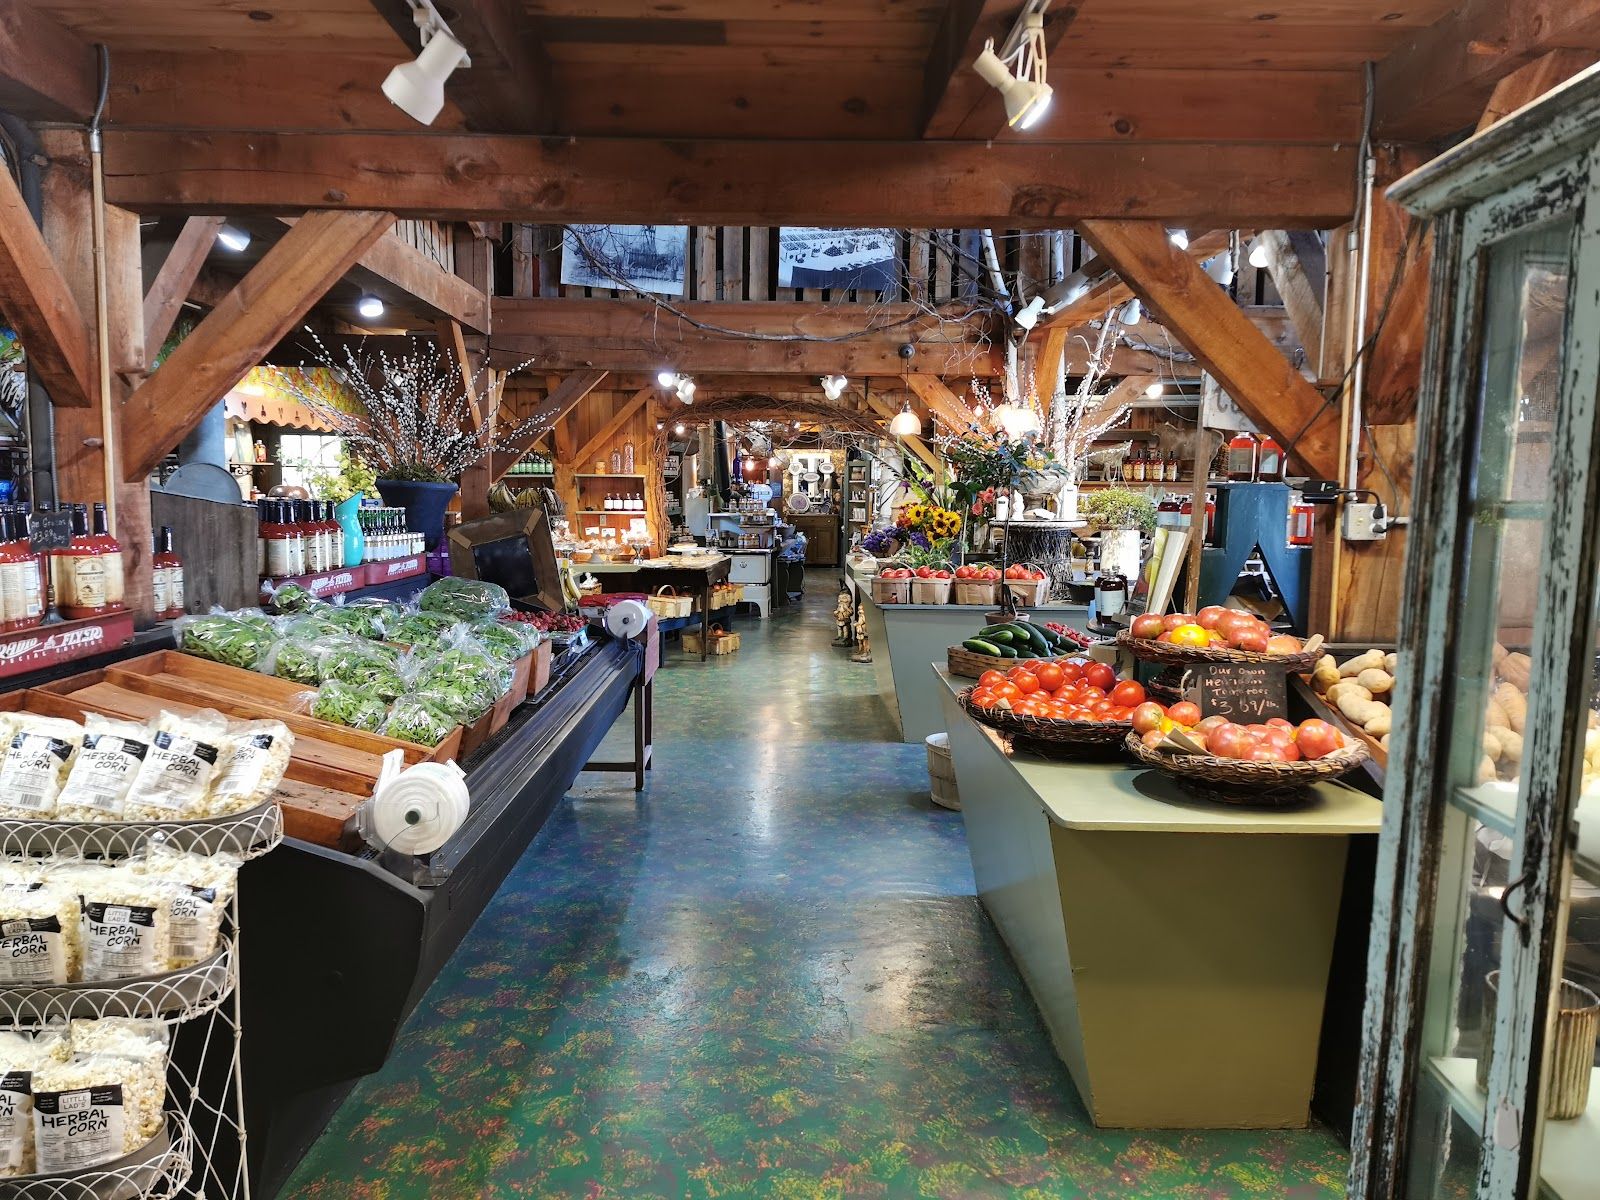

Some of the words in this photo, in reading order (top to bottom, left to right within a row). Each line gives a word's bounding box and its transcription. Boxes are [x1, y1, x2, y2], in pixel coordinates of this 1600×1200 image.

[0, 651, 46, 665] PECIAL
[1209, 665, 1231, 675] Our
[20, 759, 50, 770] CORN
[82, 752, 131, 766] HERBAL
[152, 751, 201, 770] HERBAL
[94, 761, 127, 772] CORN
[166, 763, 198, 776] CORN
[89, 922, 143, 937] HERBAL
[0, 934, 48, 948] ERBAL
[107, 936, 140, 947] CORN
[12, 944, 47, 957] CORN
[62, 1095, 87, 1104] LITTLE
[63, 1102, 86, 1110] LAD'S
[41, 1109, 110, 1128] HERBAL
[68, 1119, 108, 1136] CORN
